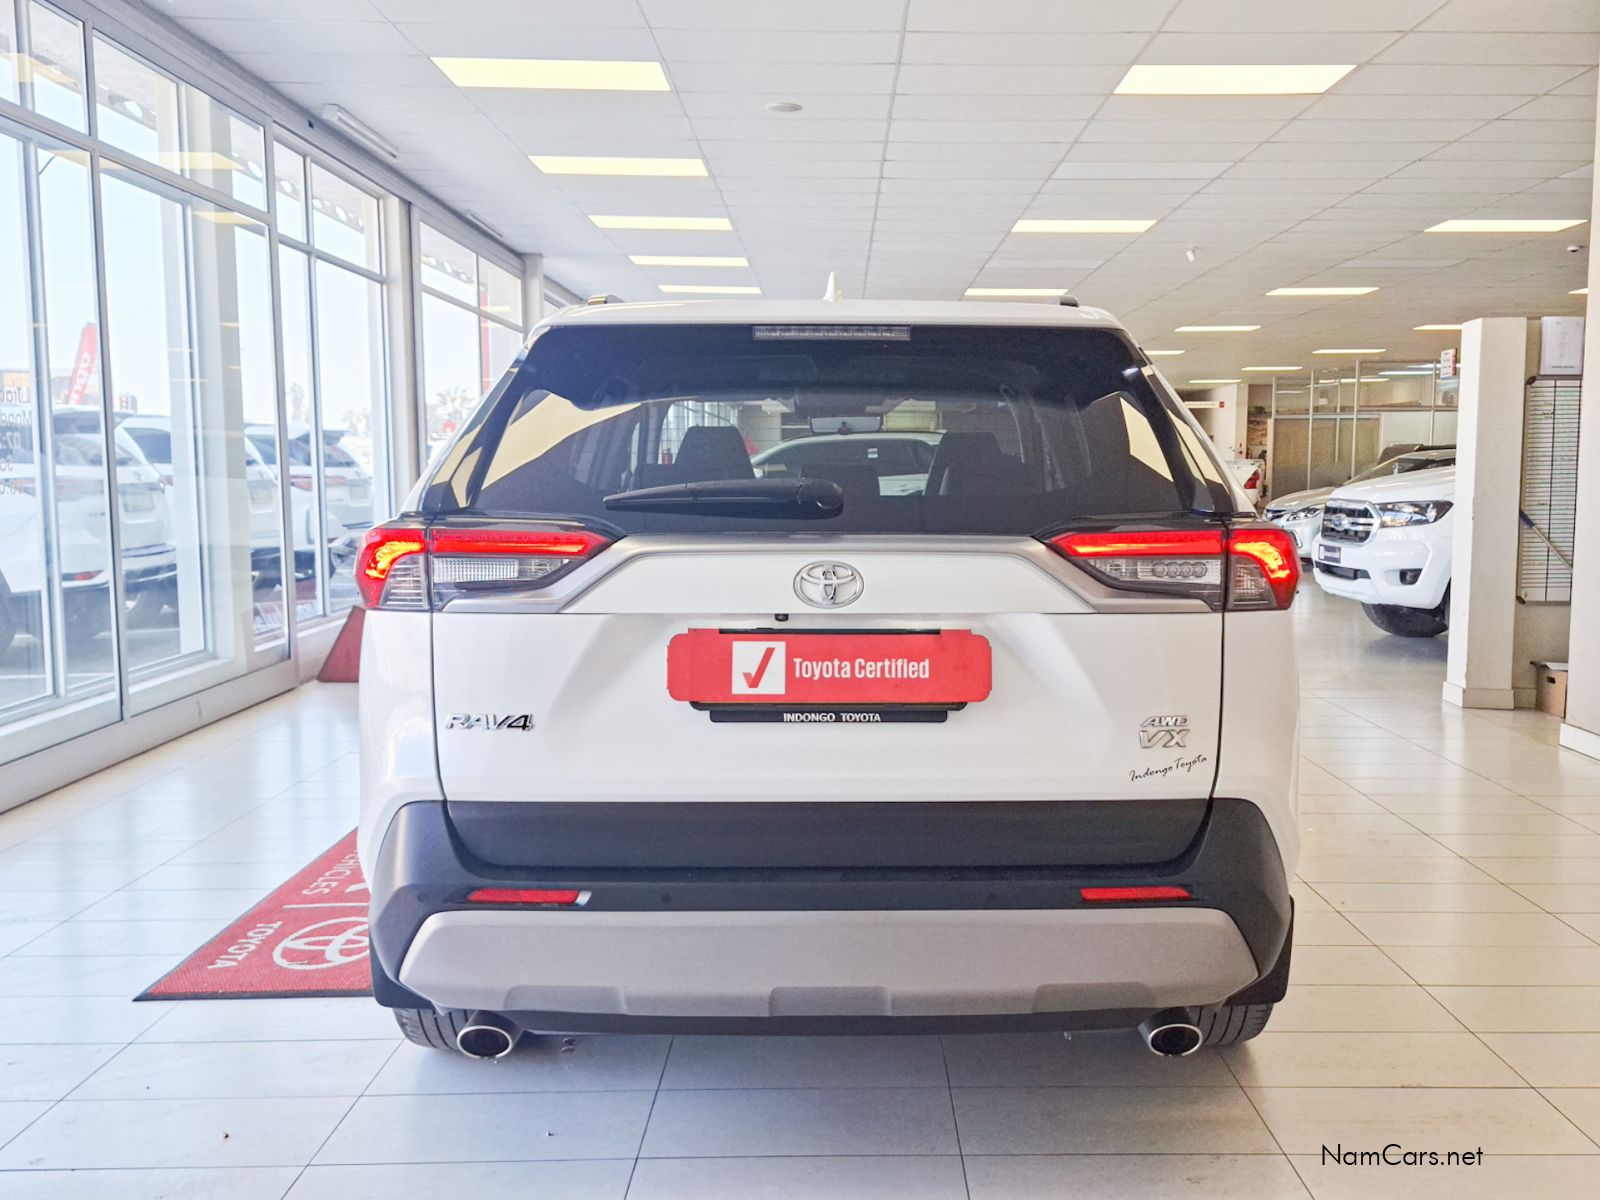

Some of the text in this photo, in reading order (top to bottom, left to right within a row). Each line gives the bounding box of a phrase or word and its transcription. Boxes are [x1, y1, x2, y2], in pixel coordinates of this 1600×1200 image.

[793, 658, 930, 680] Toyota Certified
[446, 713, 533, 732] RAV4
[783, 712, 882, 723] INDONGO TOYOTA
[1139, 728, 1191, 748] VX
[1129, 754, 1207, 782] Indongo Toyota
[207, 921, 283, 970] TOYOTA
